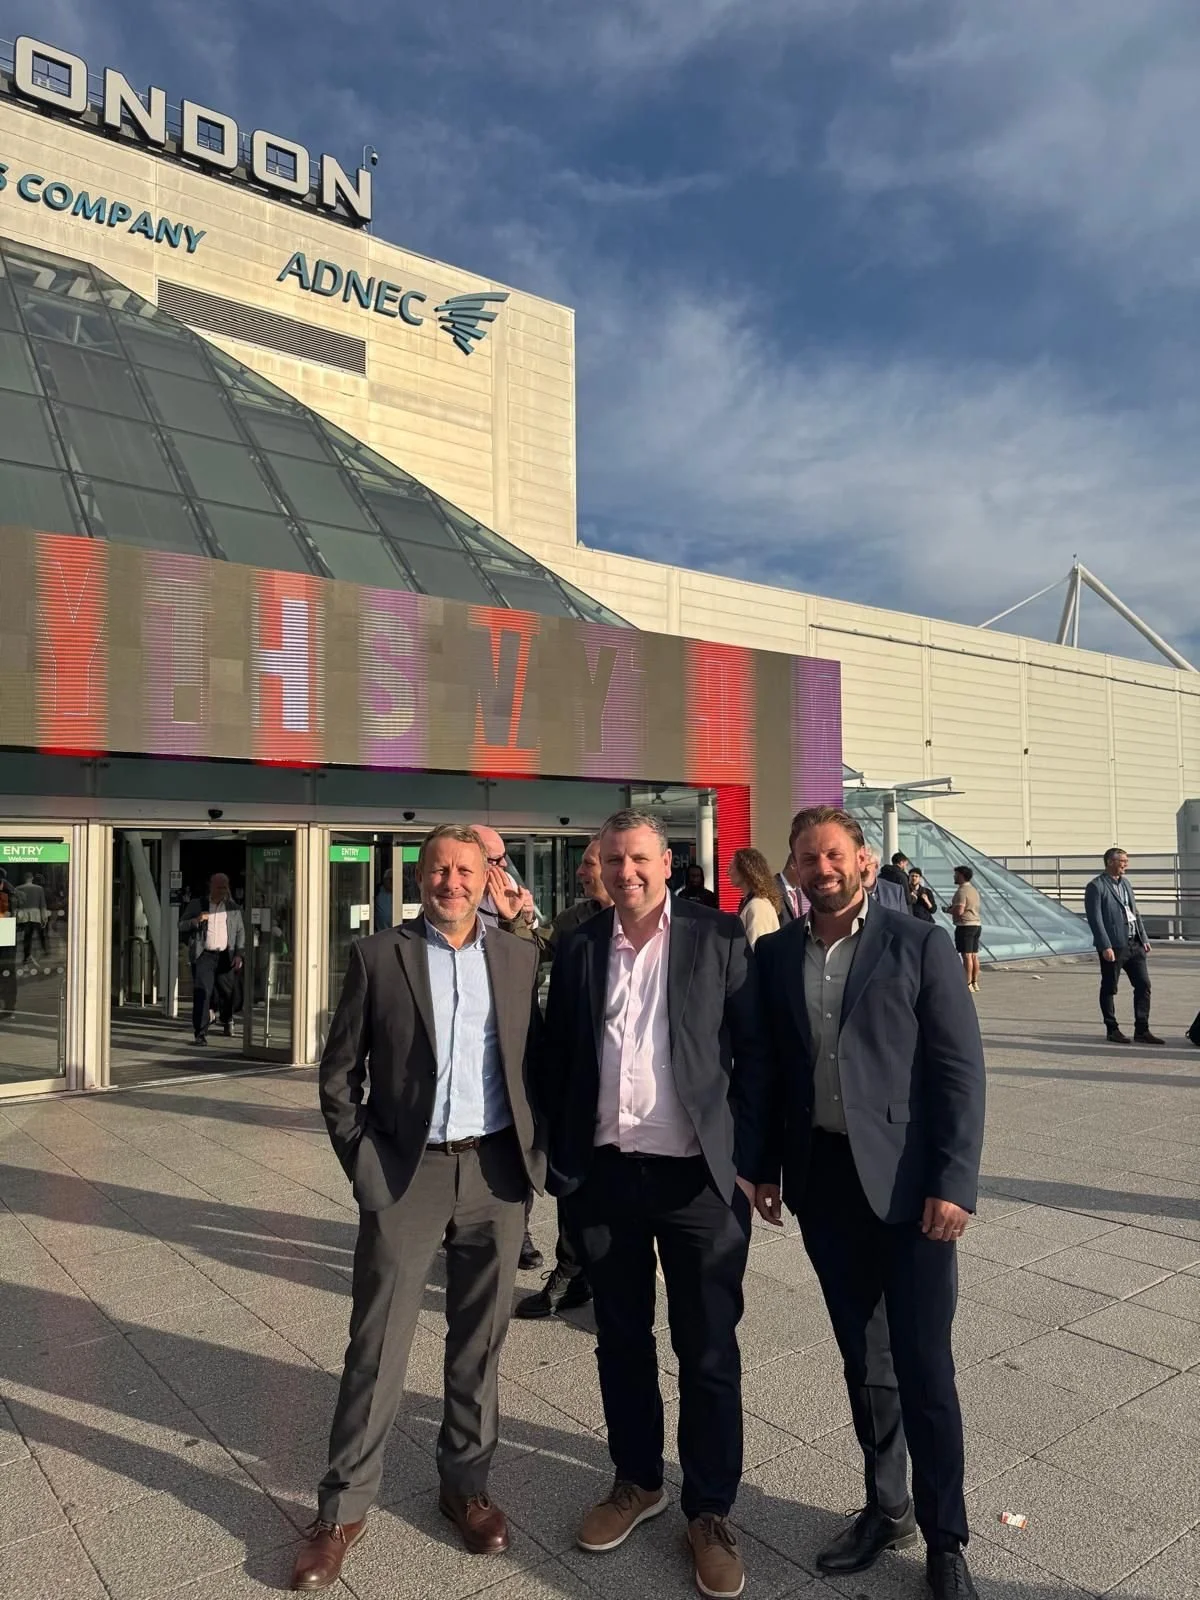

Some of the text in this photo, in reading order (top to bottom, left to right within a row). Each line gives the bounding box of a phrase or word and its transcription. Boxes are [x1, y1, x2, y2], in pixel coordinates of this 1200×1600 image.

[14, 34, 373, 223] ONDON
[16, 173, 207, 254] COMPANY
[276, 251, 428, 326] ADNEC
[3, 846, 44, 856] ENTRY
[341, 847, 360, 857] ENTRY
